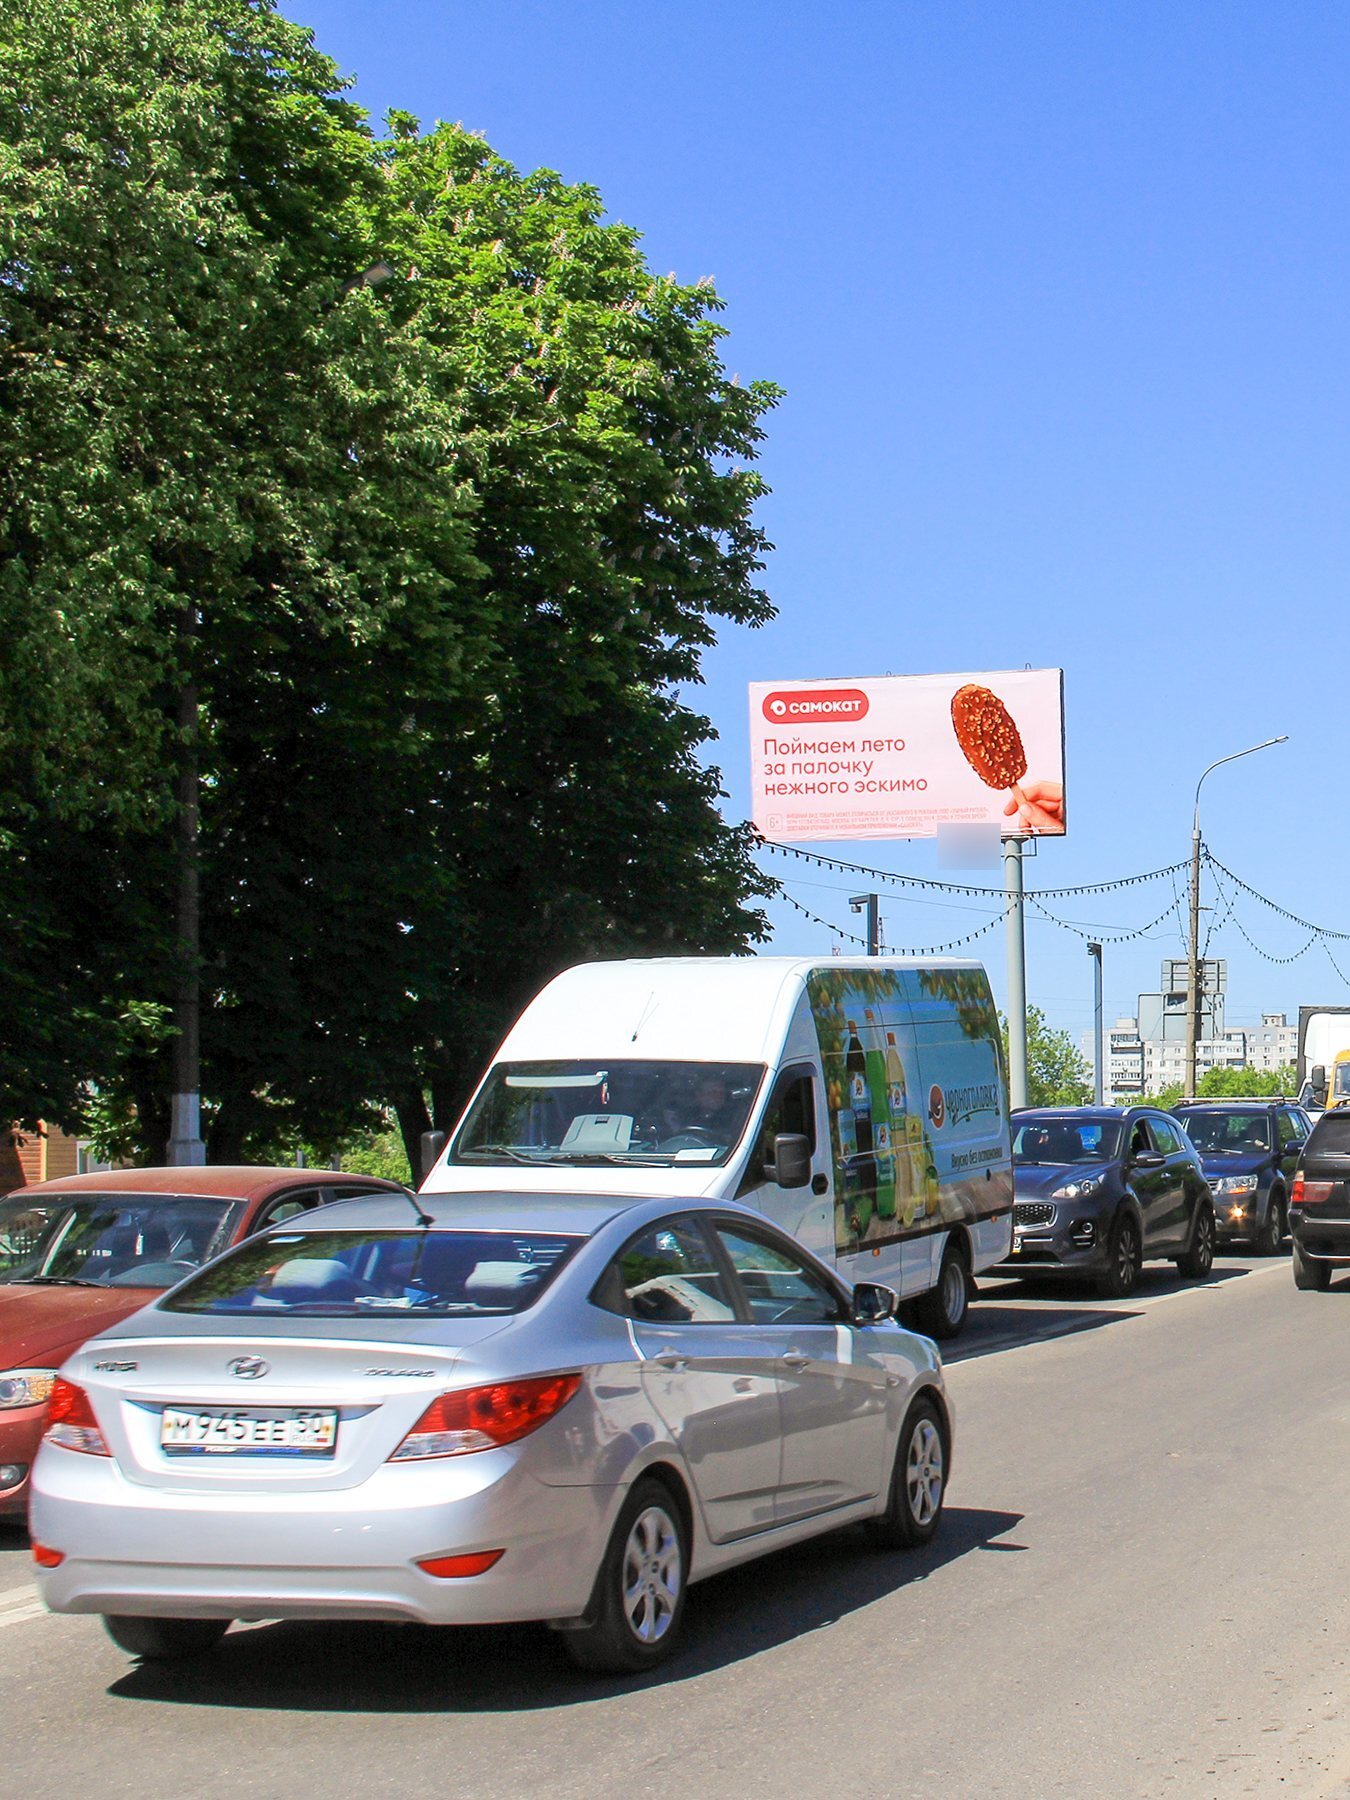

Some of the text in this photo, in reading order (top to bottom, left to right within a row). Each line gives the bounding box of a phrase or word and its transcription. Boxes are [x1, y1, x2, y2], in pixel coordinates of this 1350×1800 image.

[789, 700, 861, 714] самокат
[764, 737, 905, 755] Поймаем лето
[764, 760, 874, 777] за палочку
[765, 778, 928, 795] нежного эскимо
[172, 1412, 323, 1440] М945ЕЕ 50
